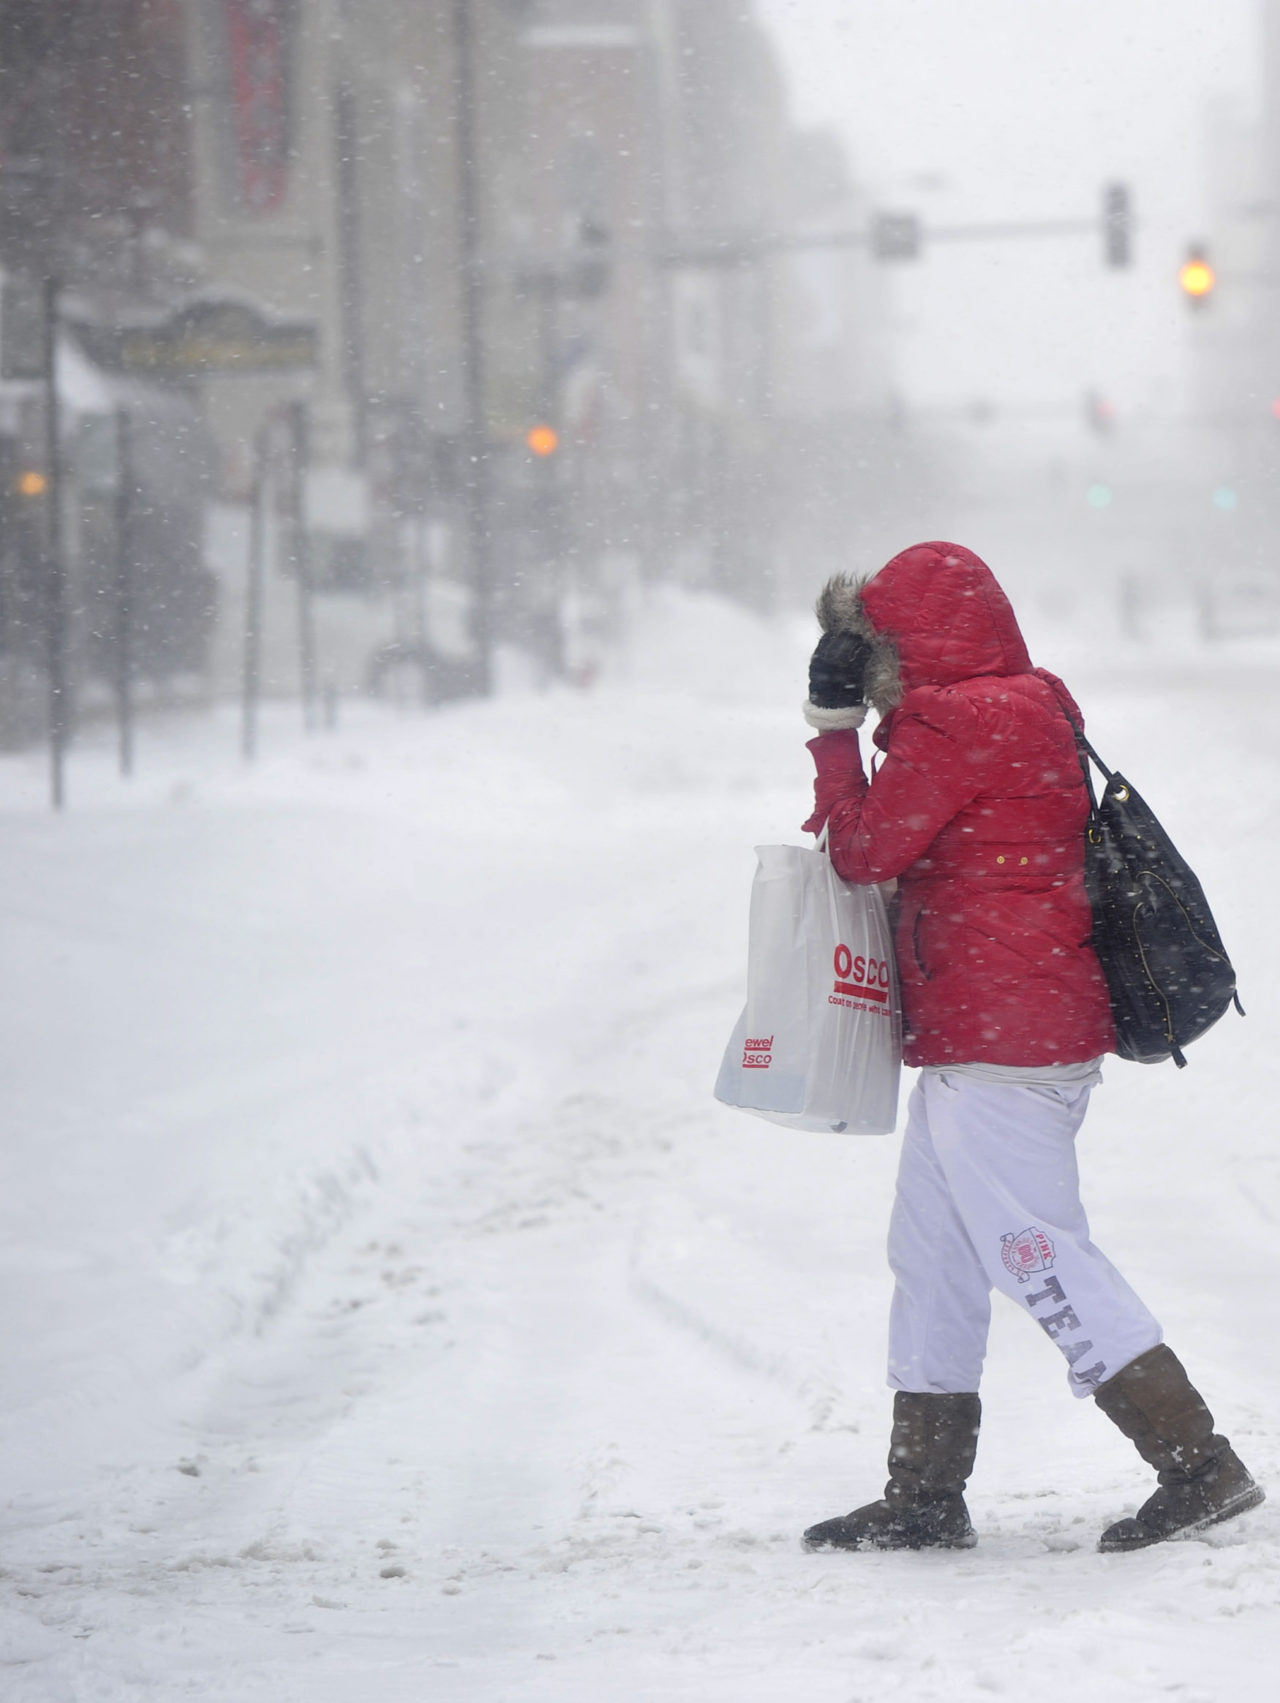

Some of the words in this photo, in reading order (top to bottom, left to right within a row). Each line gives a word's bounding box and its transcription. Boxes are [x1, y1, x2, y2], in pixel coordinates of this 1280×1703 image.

[834, 943, 889, 988] Osco
[745, 1035, 774, 1047] ewel
[1036, 1233, 1053, 1260] PINK
